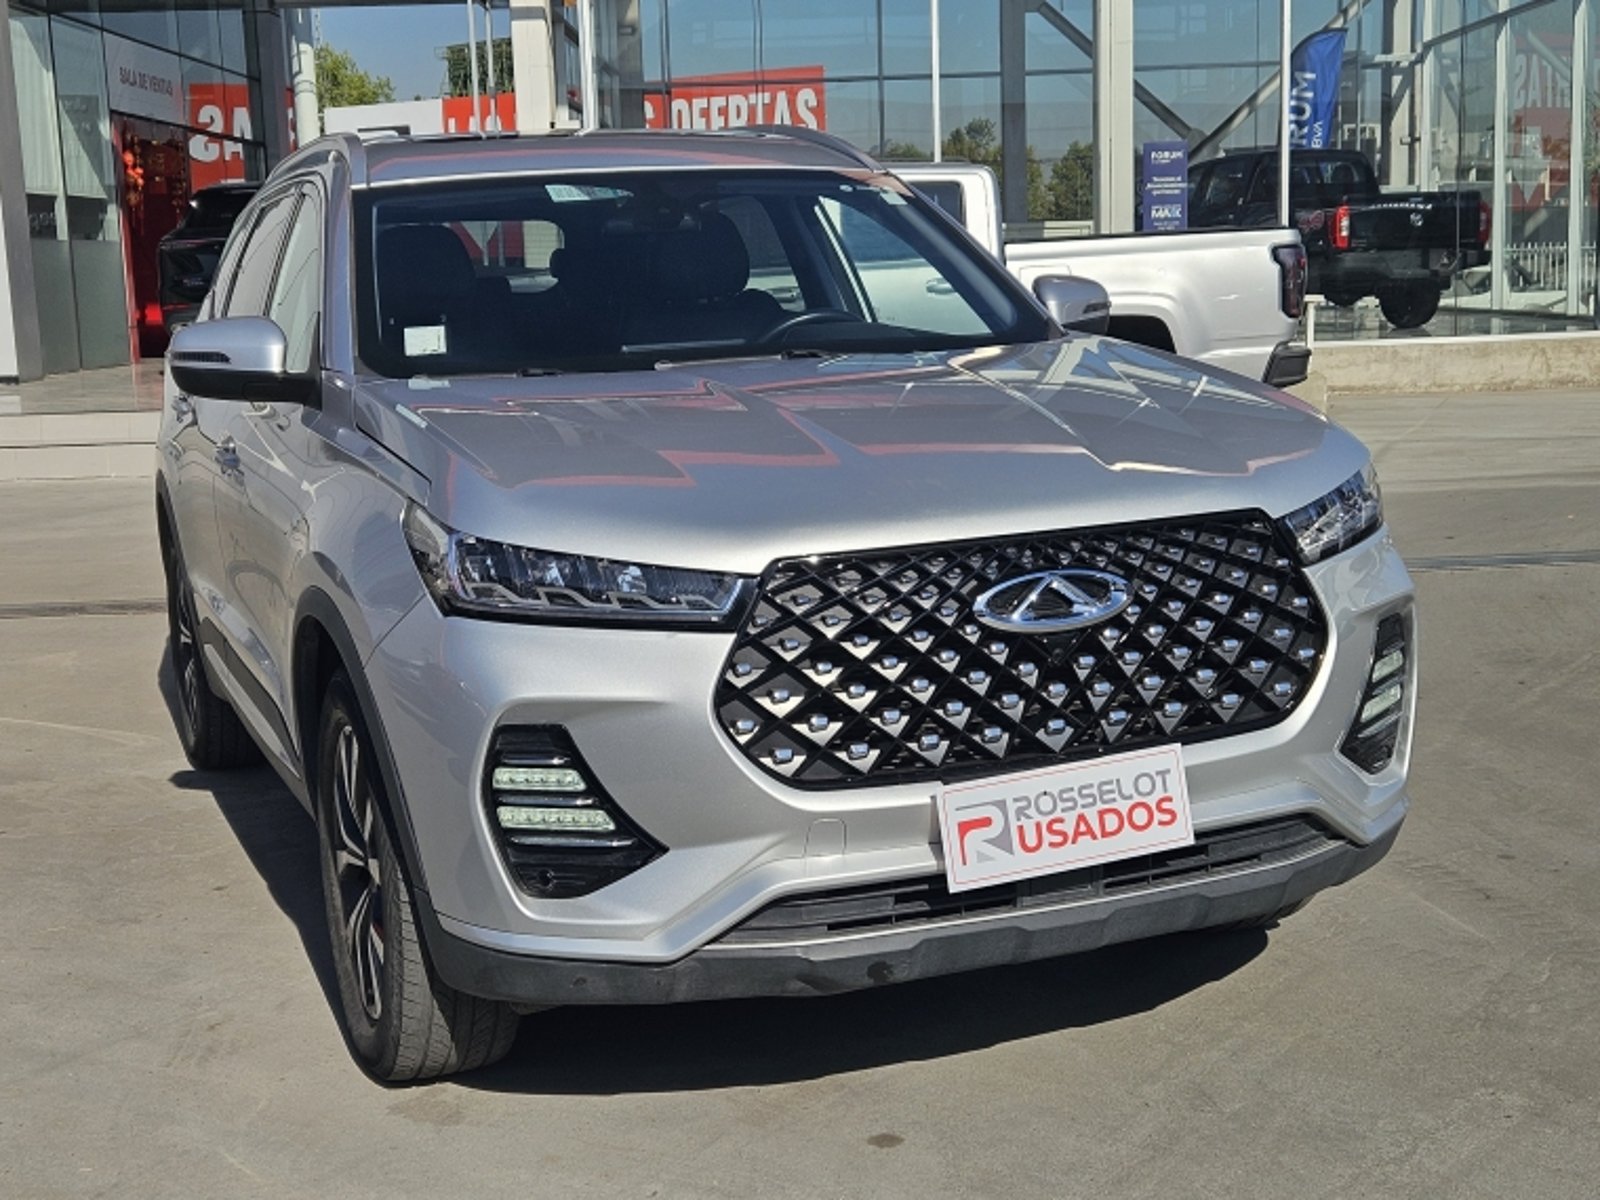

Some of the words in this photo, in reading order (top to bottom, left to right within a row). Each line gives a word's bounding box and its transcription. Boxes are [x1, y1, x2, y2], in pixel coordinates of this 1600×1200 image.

[671, 88, 818, 131] OFERTAS
[1289, 71, 1316, 147] RUM
[1311, 121, 1323, 148] BVA
[1012, 769, 1171, 822] ROSSELOT
[1017, 796, 1178, 853] USADOS
